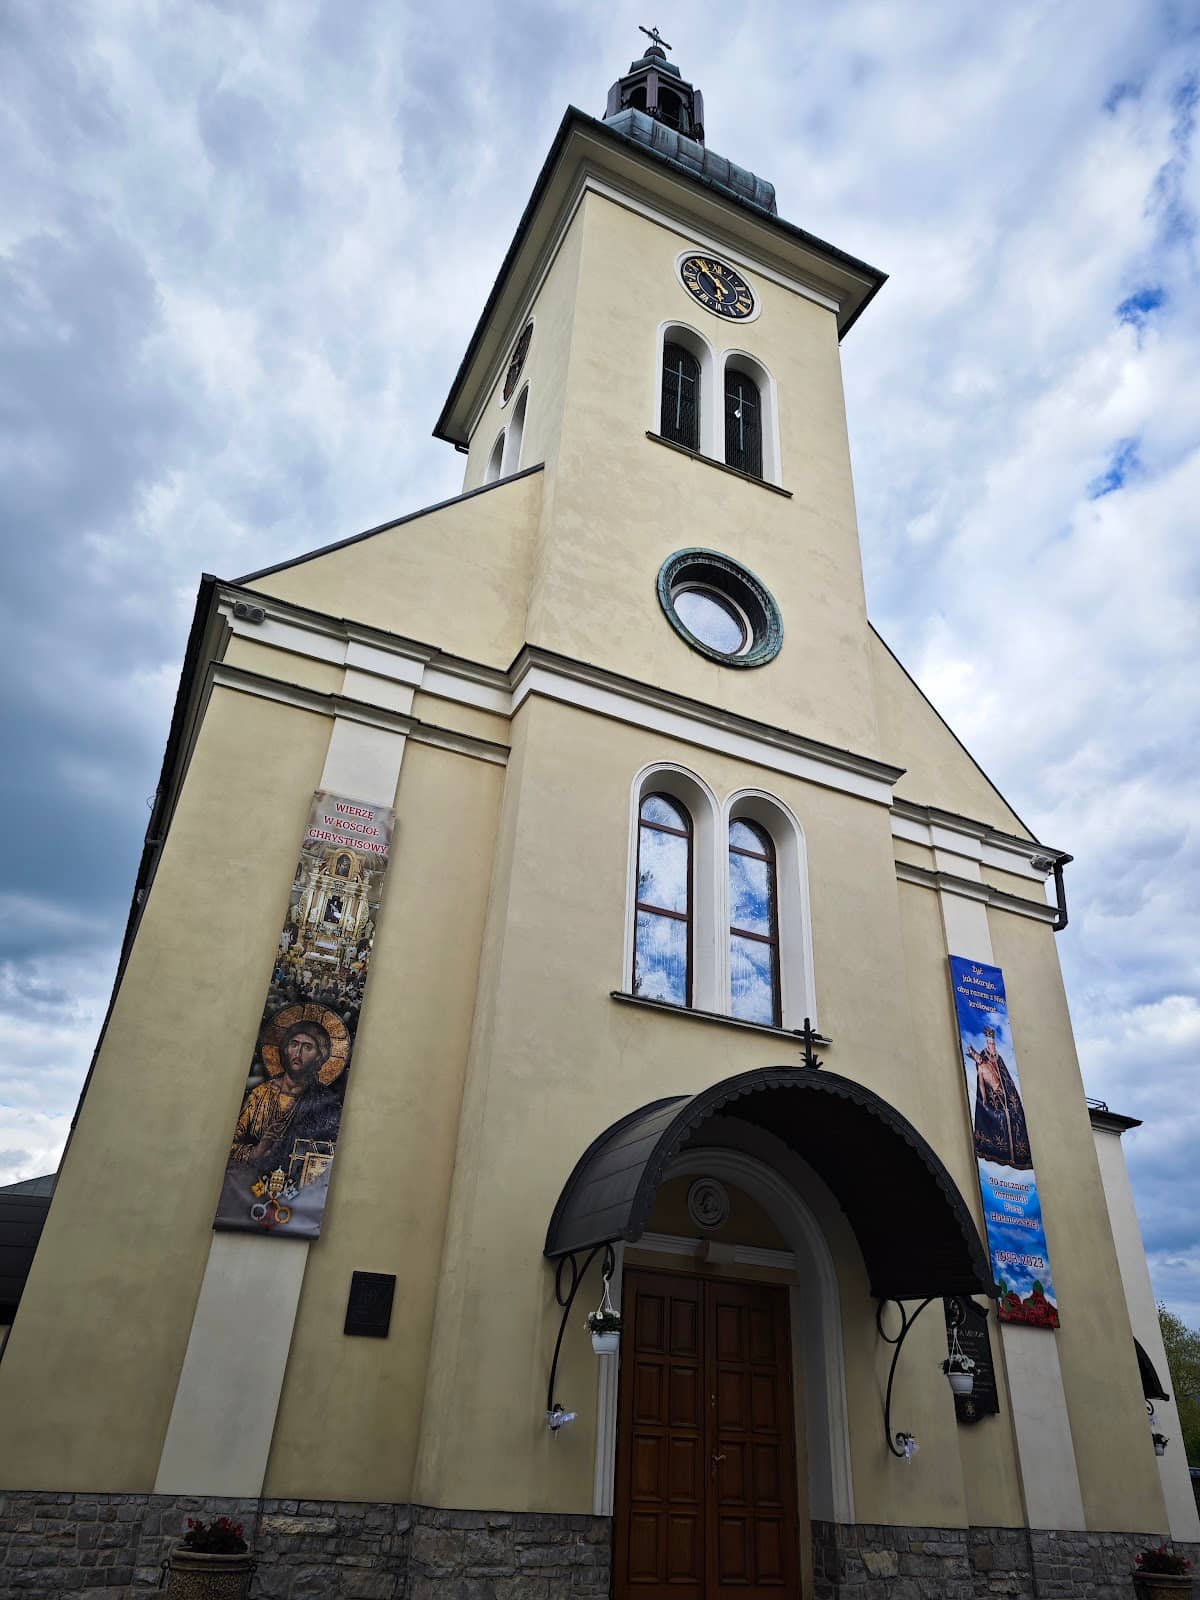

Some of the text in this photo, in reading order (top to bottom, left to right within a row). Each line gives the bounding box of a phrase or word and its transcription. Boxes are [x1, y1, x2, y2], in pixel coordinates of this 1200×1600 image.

[324, 815, 335, 825] W
[336, 803, 374, 821] WIERZĘ
[309, 828, 387, 854] CHRYSTUSOWY
